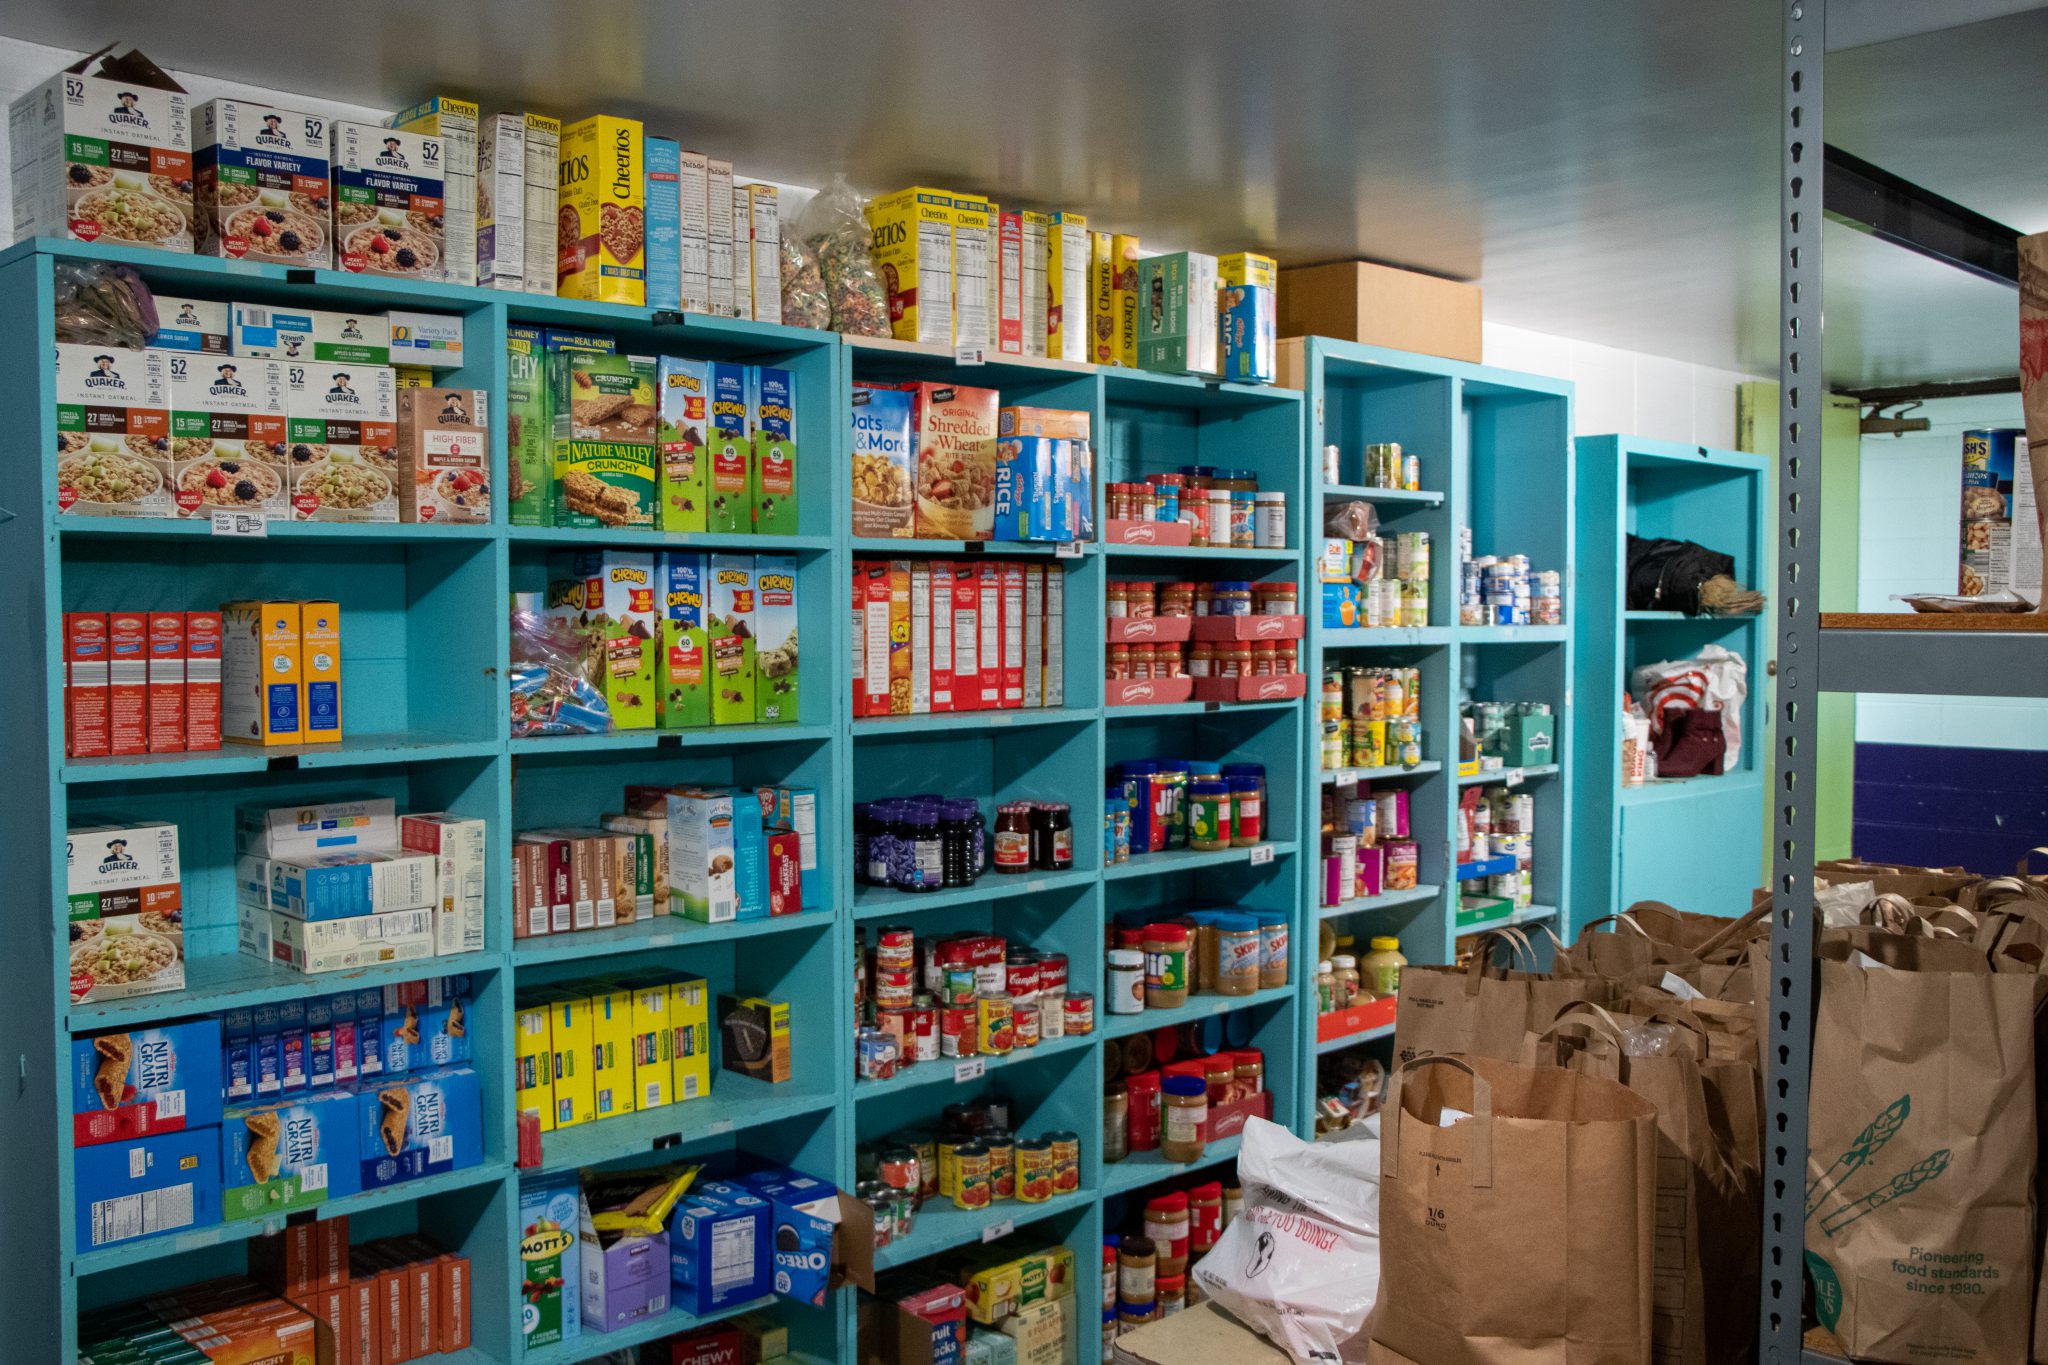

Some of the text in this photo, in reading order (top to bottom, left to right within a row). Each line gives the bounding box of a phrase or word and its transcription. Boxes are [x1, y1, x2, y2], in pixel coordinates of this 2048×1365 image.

[66, 79, 85, 98] 52
[441, 98, 477, 117] Cheerios
[109, 113, 150, 132] QUAKER
[305, 118, 323, 140] 52
[527, 116, 559, 137] Cheerios
[101, 127, 162, 144] INSTANT OATMEAL
[256, 135, 292, 150] QUAKER
[72, 143, 82, 155] 15
[111, 149, 121, 161] 27
[422, 142, 438, 160] 52
[156, 156, 166, 169] 10
[246, 157, 301, 173] FLAVOR VARIETY
[376, 156, 410, 170] QUAKER
[613, 128, 630, 200] Cheerios
[366, 177, 418, 192] FLAVOR VARIETY
[921, 208, 948, 221] Cheerios
[958, 214, 985, 227] Cheerios
[1024, 212, 1047, 226] Cheerios
[1063, 213, 1085, 226] Cheerios
[75, 228, 99, 238] HEALTHY
[78, 223, 96, 231] HEART
[226, 244, 247, 252] HEALTHY
[344, 260, 365, 268] HEALTHY
[1100, 256, 1110, 312] Cheerios
[176, 318, 200, 330] QUAKER
[1124, 296, 1136, 351] Cheerios
[418, 326, 458, 336] Variety Pack
[514, 330, 540, 341] HONEY
[341, 332, 363, 345] QUAKER
[574, 336, 616, 352] REAL HONEY
[171, 359, 188, 376] 52
[290, 368, 304, 386] 52
[595, 375, 634, 387] CRUNCHY
[668, 374, 702, 394] CHEWY
[722, 378, 738, 388] 100%
[85, 378, 126, 392] QUAKER
[768, 381, 784, 392] 100%
[210, 386, 247, 400] QUAKER
[326, 394, 360, 408] QUAKER
[712, 400, 747, 418] CHEWY
[758, 404, 793, 423] CHEWY
[942, 408, 980, 422] ORIGINAL
[88, 413, 98, 424] 27
[133, 416, 142, 428] 10
[176, 418, 185, 430] 15
[438, 414, 471, 426] QUAKER
[212, 420, 221, 432] 27
[254, 422, 262, 434] 10
[294, 425, 303, 437] 15
[328, 426, 336, 438] 27
[928, 415, 991, 438] Shredded
[366, 428, 374, 440] 10
[432, 434, 477, 446] HIGH FIBER
[856, 432, 906, 454] & More
[937, 434, 980, 456] Wheat
[572, 442, 610, 463] NATURE
[611, 444, 652, 467] VALLEY
[726, 448, 735, 456] 60
[773, 450, 782, 460] 60
[945, 452, 975, 462] BITE SIZE
[586, 459, 640, 477] CRUNCHY
[996, 466, 1012, 517] RICE
[296, 502, 318, 510] HEALTHY
[299, 498, 314, 506] HEART
[610, 568, 648, 584] CHEWY
[676, 567, 694, 576] 100%
[718, 570, 749, 586] CHEWY
[759, 574, 794, 592] CHEWY
[666, 592, 702, 608] CHEWY
[681, 638, 690, 646] 60
[1156, 786, 1184, 816] Jif
[322, 804, 368, 818] Variety Pack
[98, 861, 138, 874] QUAKER
[90, 874, 150, 886] INSTANT OATMEAL
[782, 854, 790, 896] BREAKFAST
[560, 874, 568, 895] CHEWY
[102, 898, 112, 909] 27
[147, 892, 156, 902] 10
[972, 945, 1001, 960] Campbell's
[70, 978, 88, 986] HEART
[140, 1043, 156, 1089] GRAIN
[152, 1041, 168, 1087] NUTRI
[417, 1095, 430, 1137] GRAIN
[428, 1093, 440, 1135] NUTRI
[287, 1120, 301, 1163] GRAIN
[300, 1118, 313, 1161] NUTRI
[1428, 1208, 1444, 1220] 1/6
[714, 1217, 754, 1232] Nutrition Facts
[1268, 1210, 1296, 1232] YOU
[1296, 1217, 1339, 1253] DOING?
[521, 1234, 570, 1256] MOTT'S
[776, 1252, 826, 1270] OREO
[1910, 1246, 1985, 1265] Pioneering
[1892, 1259, 2000, 1280] food standards
[1906, 1280, 1986, 1296] since 1980.
[682, 1349, 734, 1365] CHEWY
